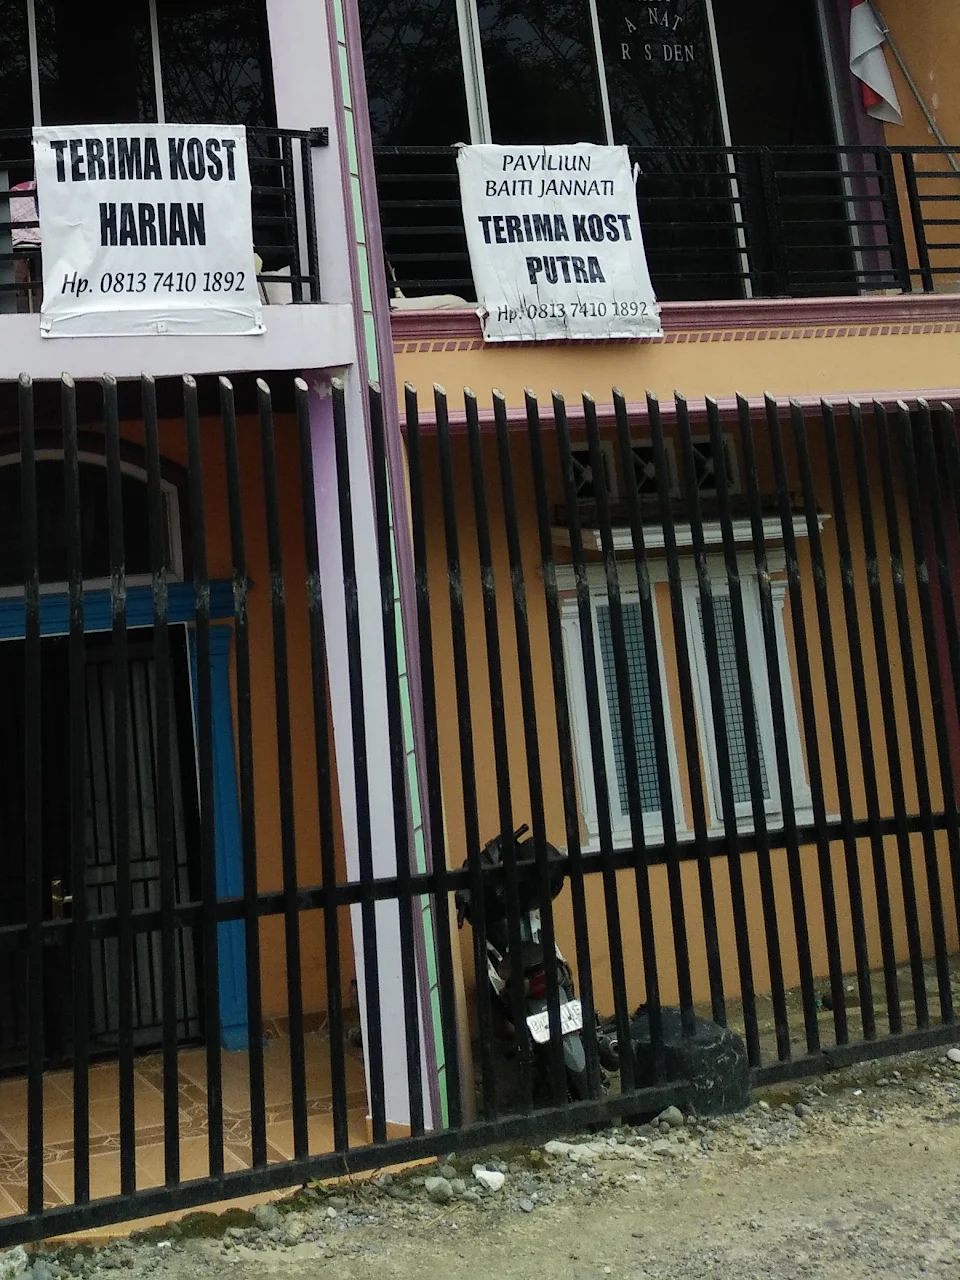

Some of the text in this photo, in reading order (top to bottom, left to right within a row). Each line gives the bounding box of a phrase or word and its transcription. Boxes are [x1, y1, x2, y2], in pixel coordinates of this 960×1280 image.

[49, 137, 236, 182] TERIMA KOST
[502, 155, 591, 171] PAVILIUN
[485, 179, 614, 198] BAITI JANNATI
[98, 202, 206, 247] HARIAN
[478, 213, 633, 244] TERIMA KOST
[61, 271, 245, 297] Hp. 0813 7410 1892
[525, 255, 606, 285] PUTRA
[527, 303, 566, 319] 0813
[570, 302, 607, 318] 7410
[611, 301, 649, 317] 1892
